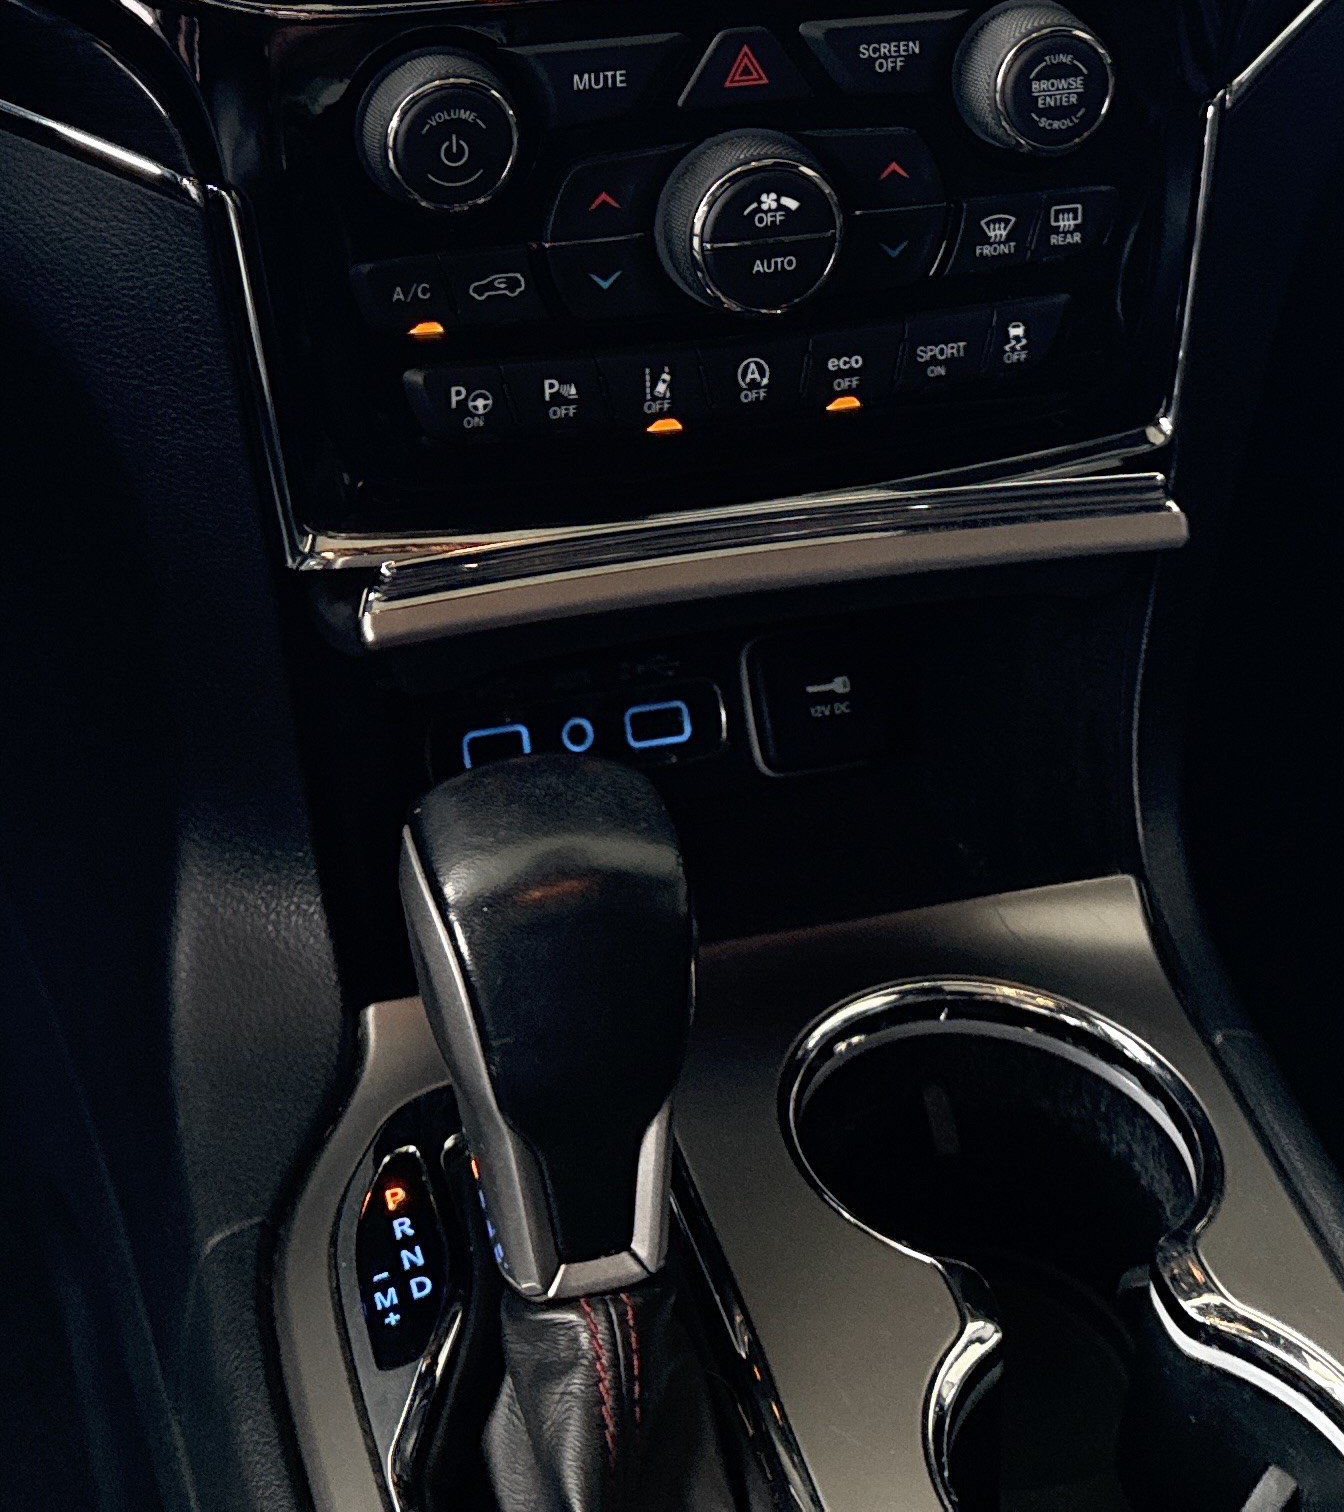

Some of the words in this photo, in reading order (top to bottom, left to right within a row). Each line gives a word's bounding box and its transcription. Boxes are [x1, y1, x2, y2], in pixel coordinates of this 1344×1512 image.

[859, 40, 920, 59] SCREEN
[875, 57, 906, 73] OFF
[1044, 54, 1075, 67] TUNE
[573, 70, 627, 91] MUTE
[1031, 76, 1084, 92] BROWSE
[1037, 93, 1078, 108] ENTER
[426, 109, 477, 127] VOLUME
[1037, 116, 1080, 130] SCROLL
[754, 212, 786, 227] OFF
[1050, 232, 1082, 245] REAR
[975, 242, 1017, 257] FRONT
[752, 255, 797, 274] AUTO
[392, 283, 431, 302] A/C
[916, 342, 967, 363] SPORT
[1003, 351, 1029, 364] OFF
[828, 355, 863, 372] eco
[927, 366, 946, 378] ON
[833, 376, 860, 391] OFF
[740, 388, 768, 403] OFF
[549, 405, 578, 419] OFF
[643, 400, 672, 414] OFF
[463, 417, 485, 429] ON
[385, 1188, 406, 1211] P
[392, 1217, 415, 1240] R
[400, 1246, 425, 1270] N
[409, 1276, 433, 1300] D
